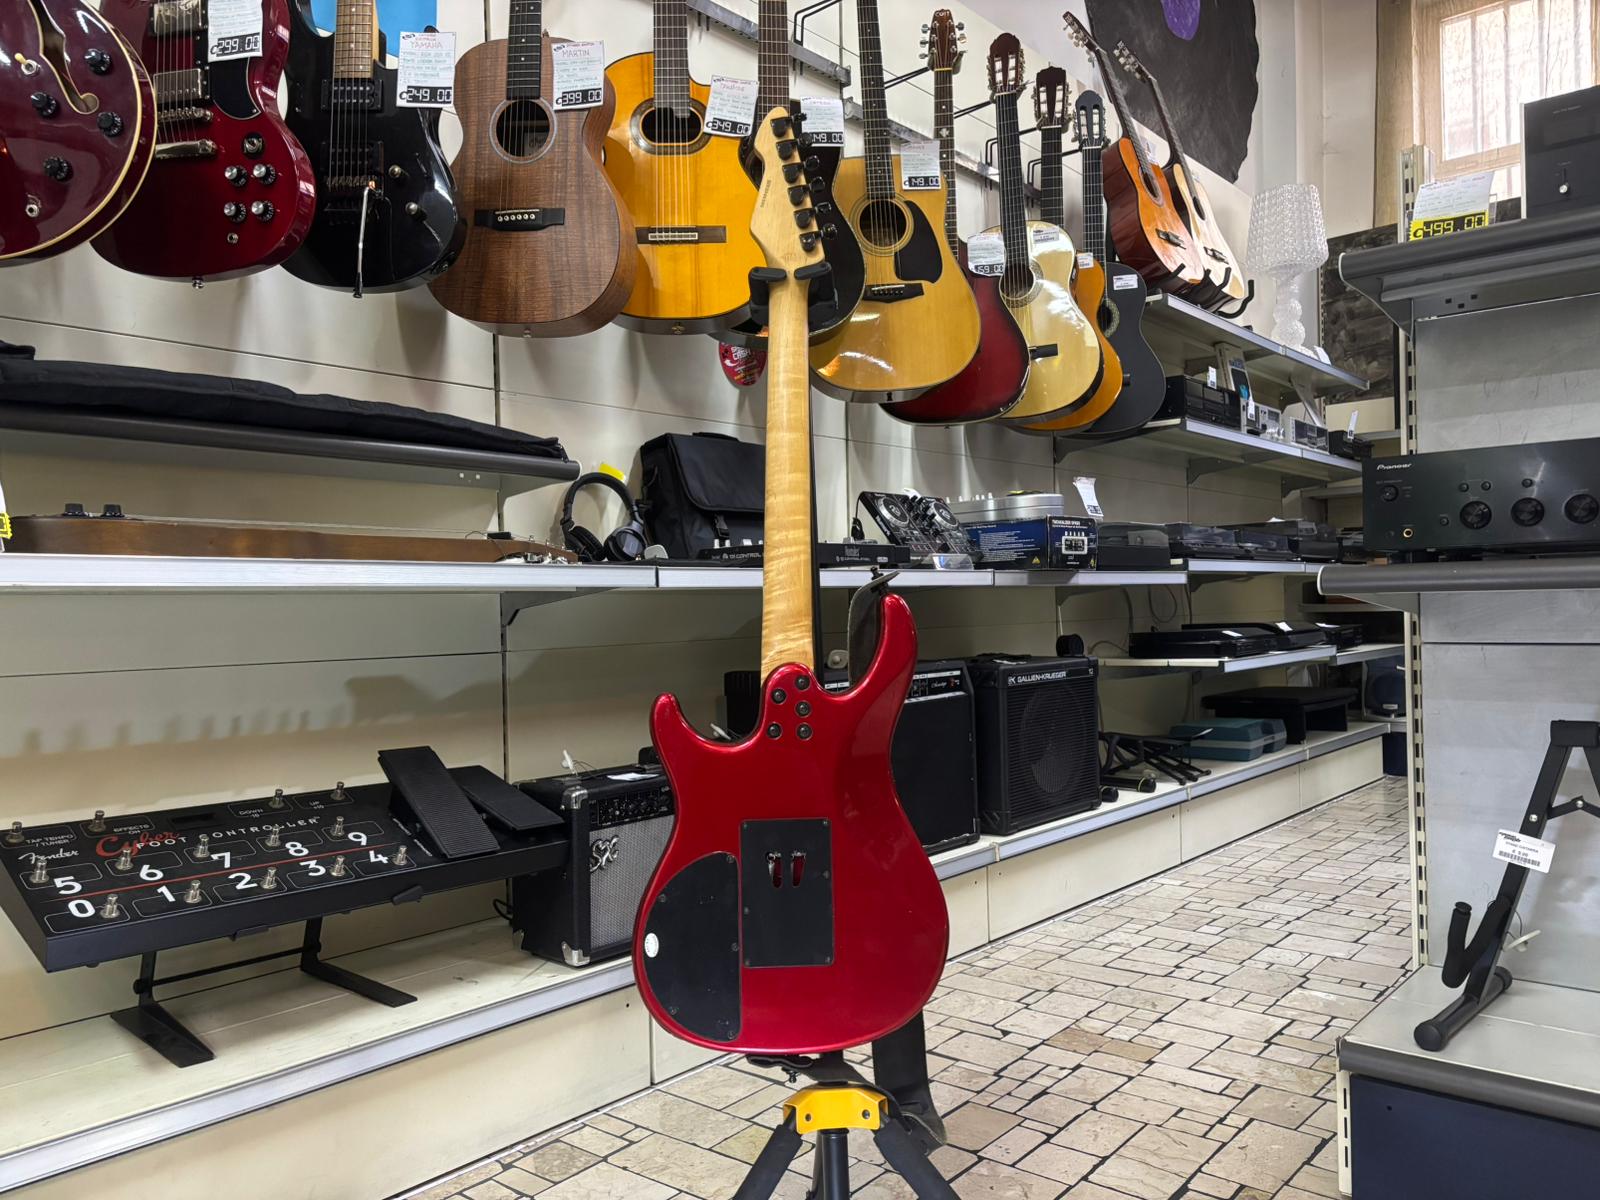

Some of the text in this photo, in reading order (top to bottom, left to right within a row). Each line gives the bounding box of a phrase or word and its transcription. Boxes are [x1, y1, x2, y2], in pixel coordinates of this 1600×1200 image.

[1017, 671, 1067, 683] GALLIEN-KRUEGER
[45, 834, 74, 842] TEMPO
[96, 831, 180, 857] Cyber
[136, 837, 187, 849] FOOT
[347, 832, 367, 846] 9
[18, 848, 79, 865] Fender
[285, 841, 309, 857] 8
[368, 850, 389, 864] 4
[210, 851, 231, 868] 7
[139, 864, 164, 881] 6
[300, 860, 326, 877] 3
[53, 876, 82, 895] 5
[228, 872, 257, 890] 2
[157, 885, 176, 903] 1
[68, 900, 96, 918] 0
